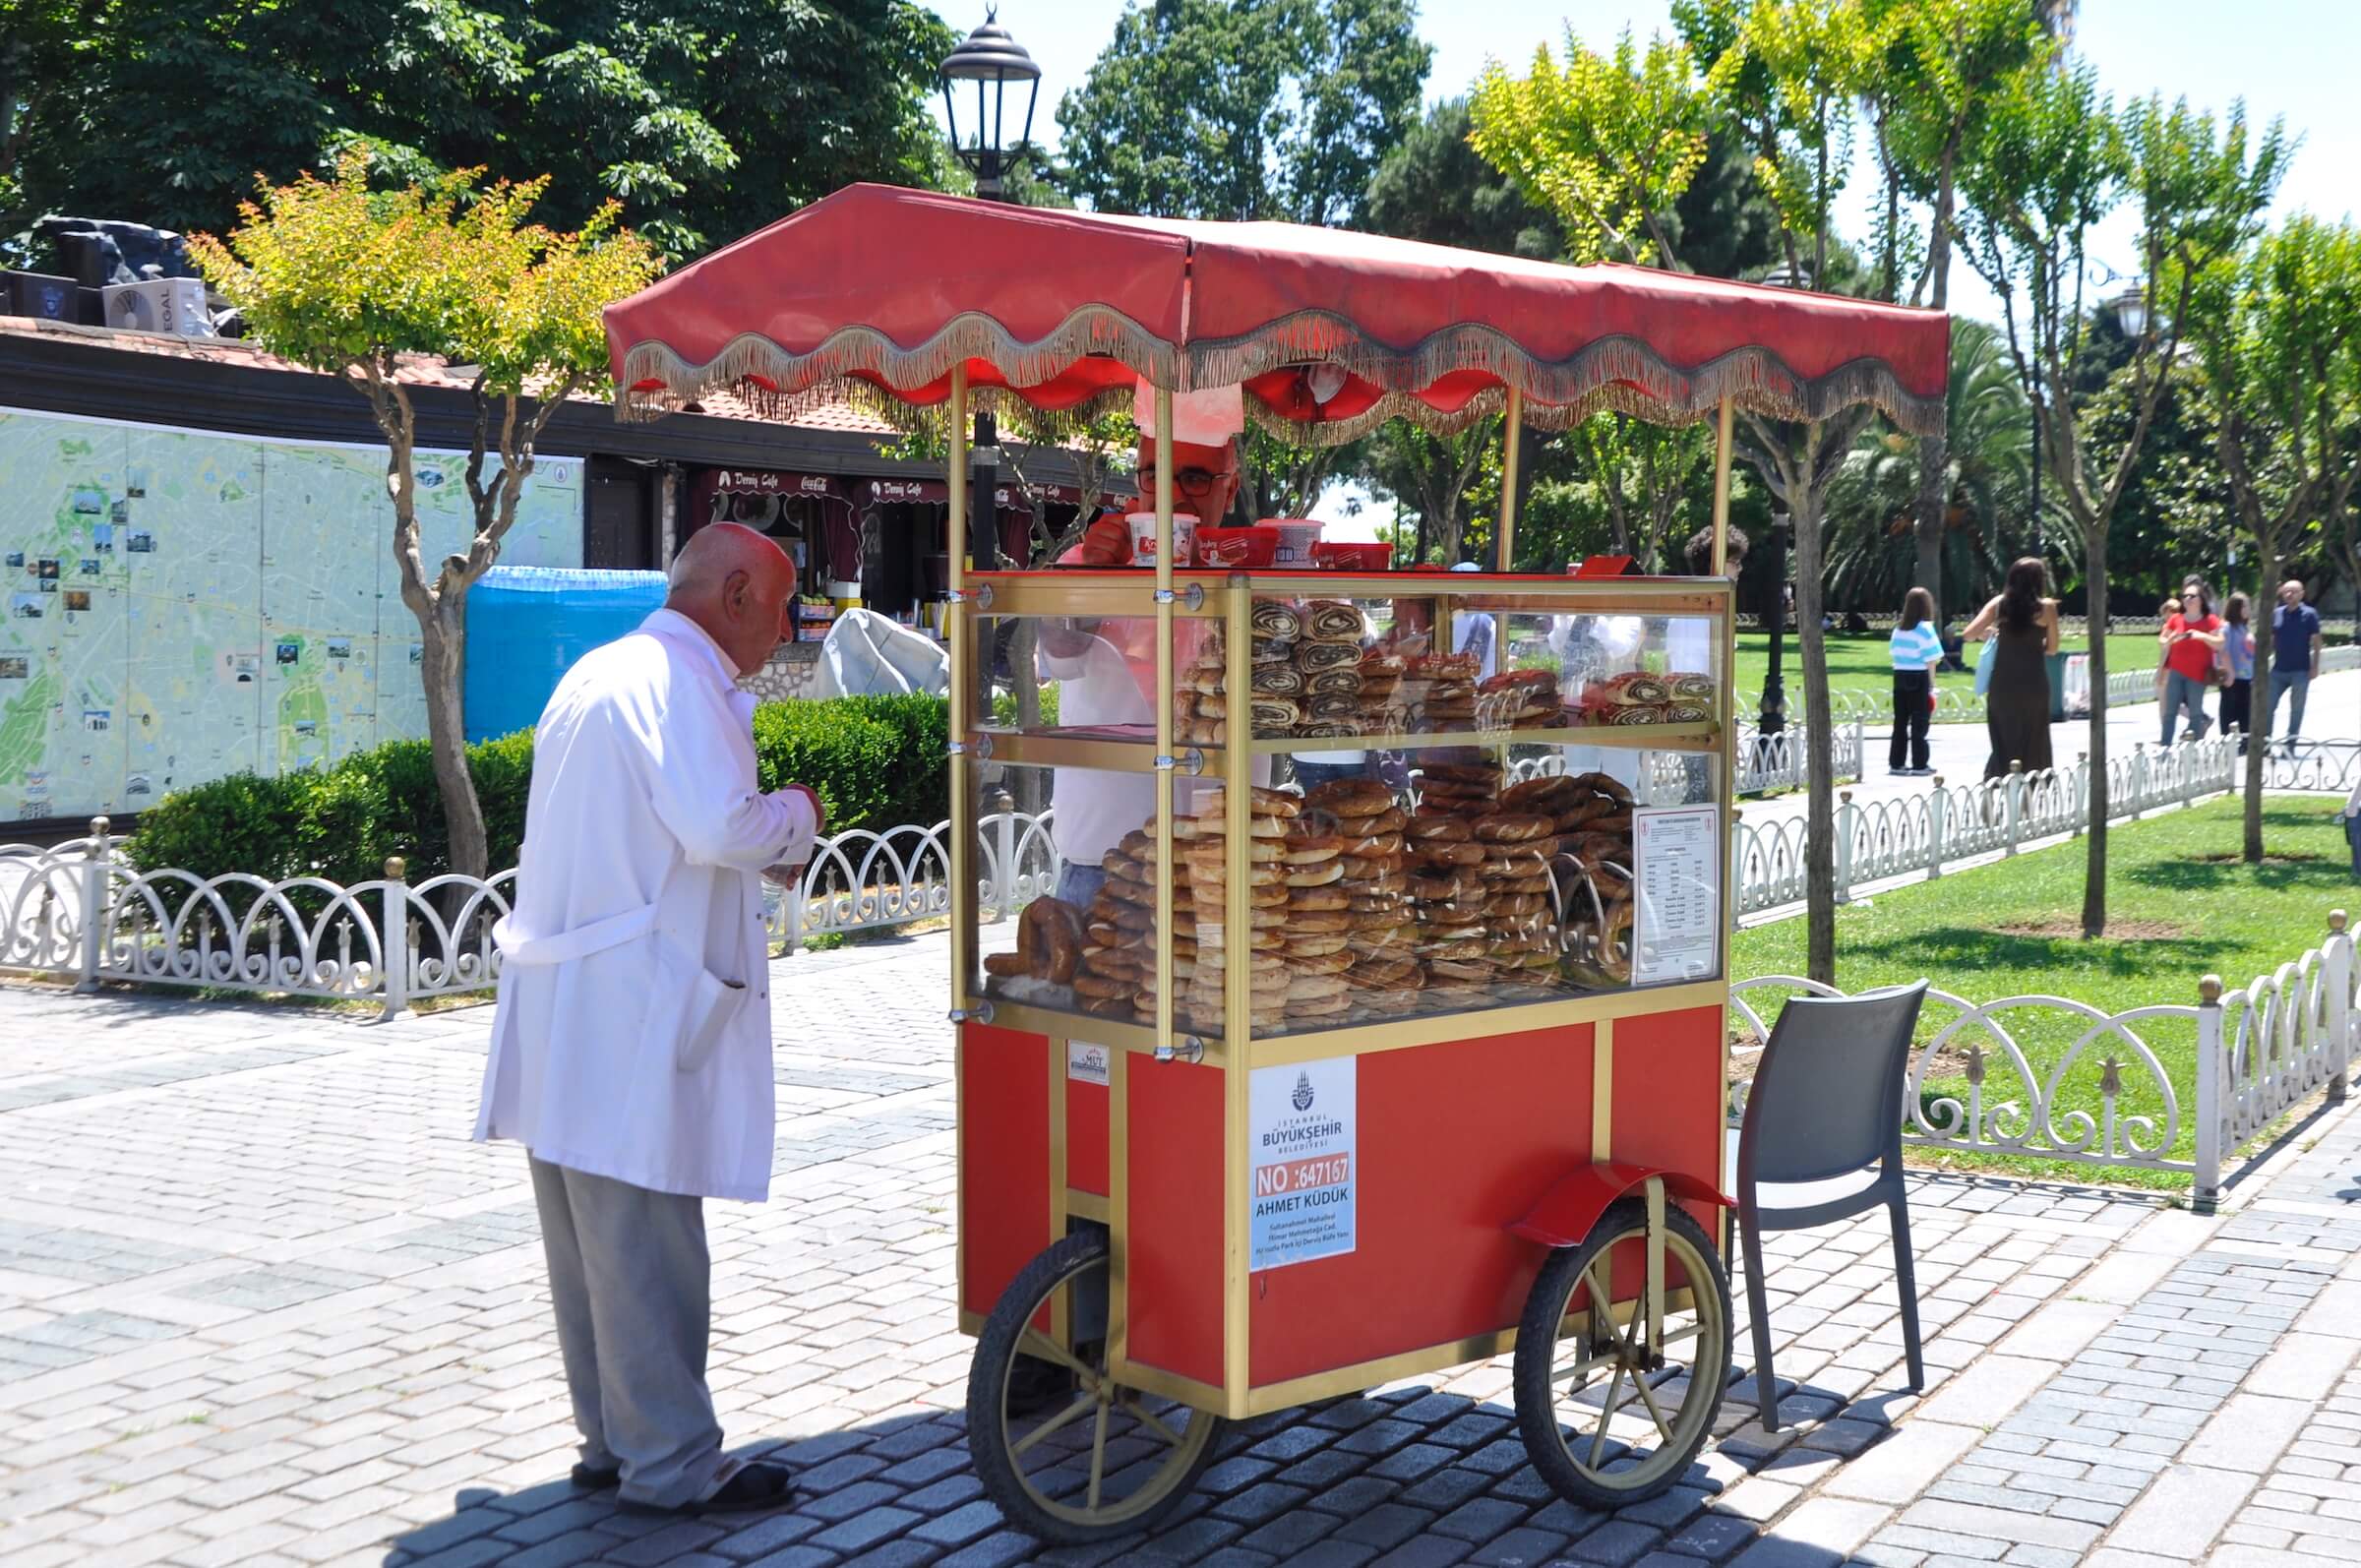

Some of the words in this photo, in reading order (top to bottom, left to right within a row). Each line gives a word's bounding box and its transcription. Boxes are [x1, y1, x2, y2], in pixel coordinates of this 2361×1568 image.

[761, 474, 779, 489] Cafe
[907, 482, 923, 497] Cafe
[1262, 1118, 1342, 1147] BÜYÜKŞEHİR
[1278, 1138, 1328, 1155] BELEDİYESİ
[1258, 1165, 1288, 1195] NO
[1256, 1196, 1302, 1218] AHMET
[1303, 1186, 1349, 1209] KÜDÜK
